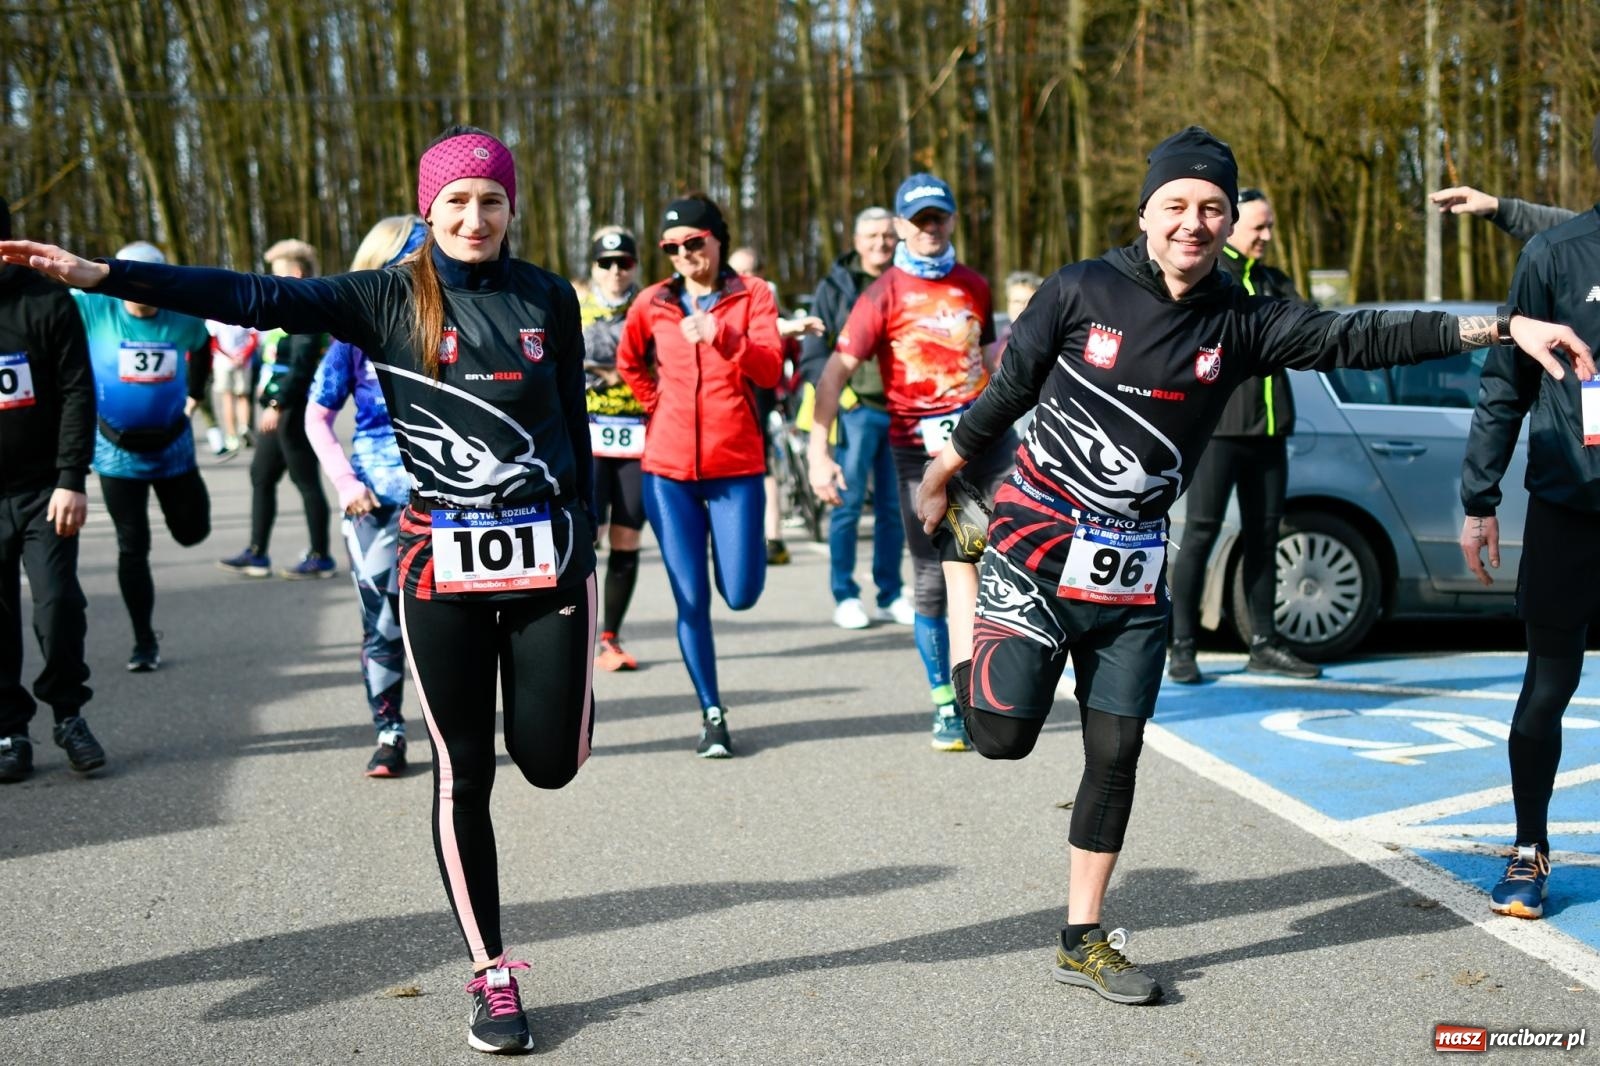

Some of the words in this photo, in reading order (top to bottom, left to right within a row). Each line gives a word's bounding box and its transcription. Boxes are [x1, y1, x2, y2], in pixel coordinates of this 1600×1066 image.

[1091, 322, 1123, 336] POLSKA
[135, 352, 165, 371] 37
[0, 368, 18, 394] 0
[602, 427, 631, 446] 98
[940, 420, 954, 441] 3
[480, 506, 537, 520] TWRDZIELA
[1105, 518, 1136, 529] PKO
[1089, 528, 1101, 536] XII
[1100, 530, 1120, 540] BIEG
[1120, 533, 1157, 542] TWARDZIELA
[453, 526, 536, 572] 101
[1090, 548, 1147, 588] 96
[559, 605, 577, 615] 4F
